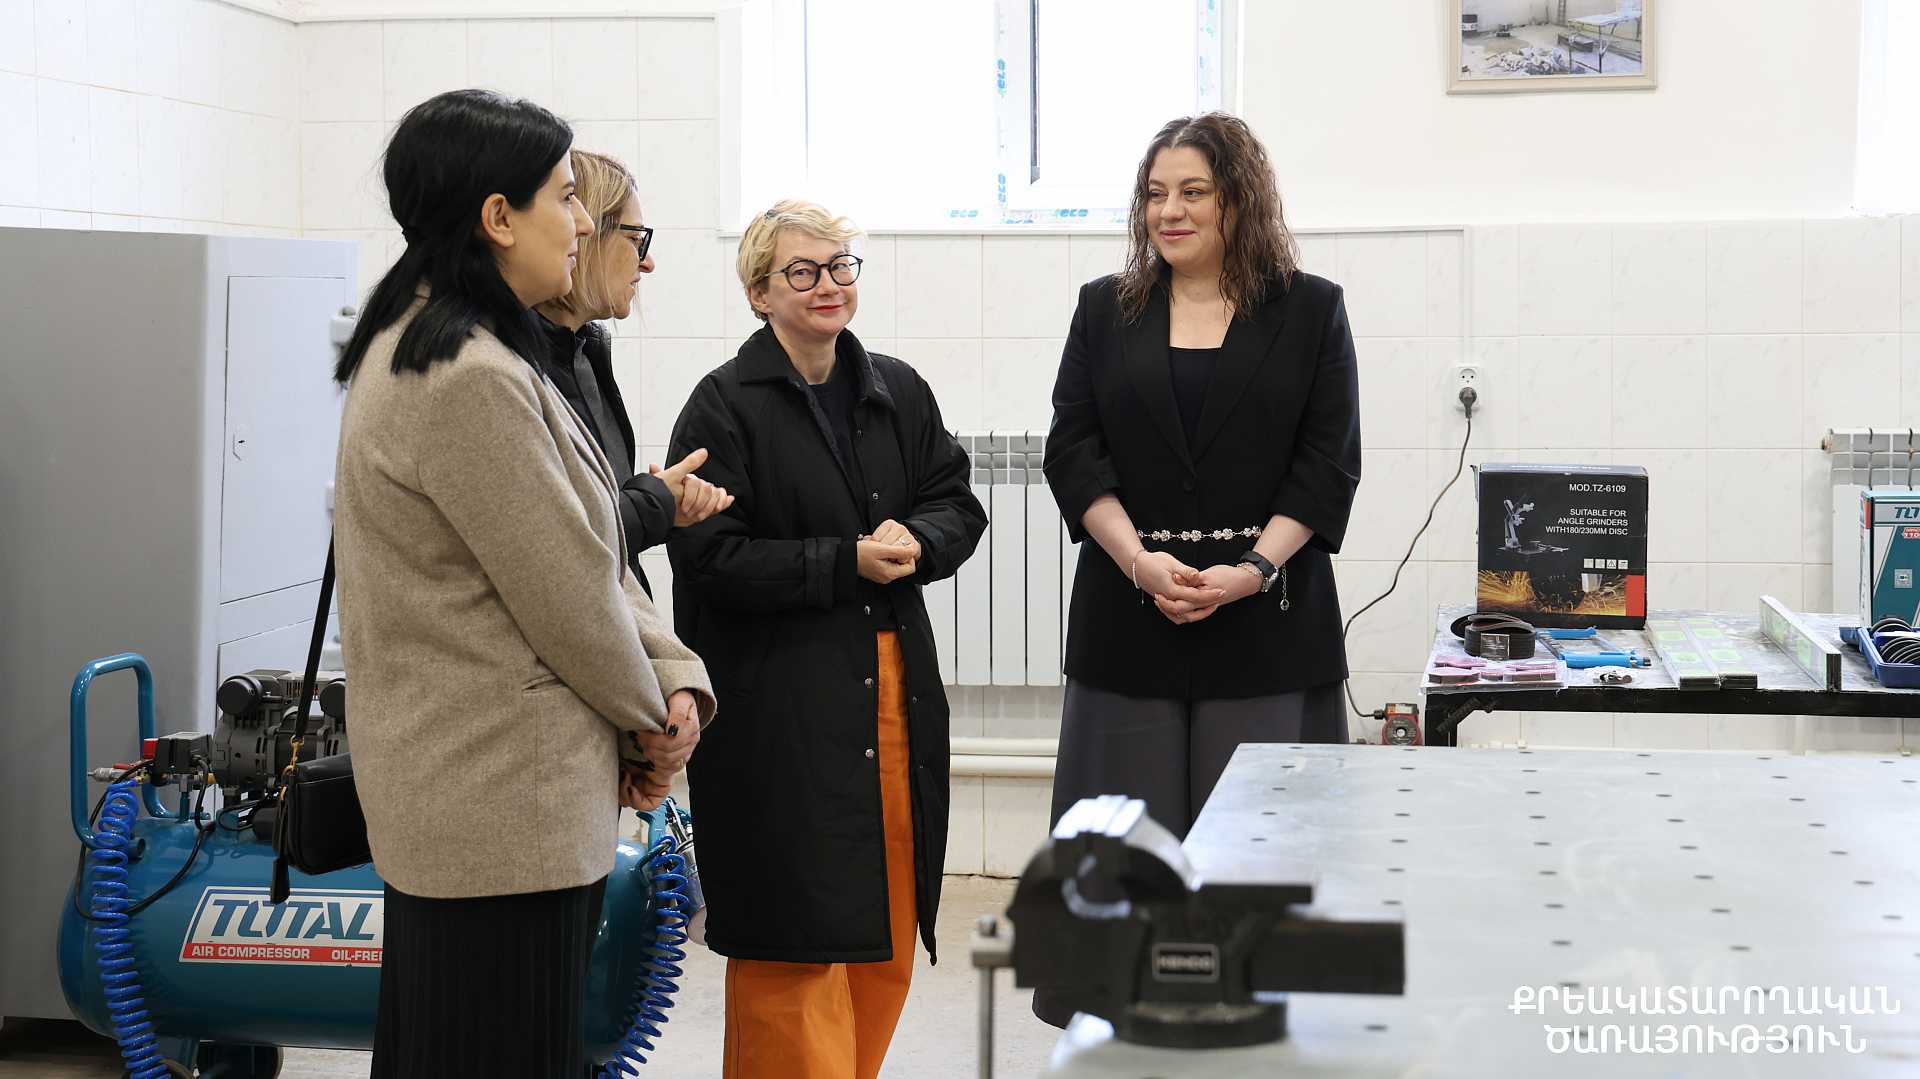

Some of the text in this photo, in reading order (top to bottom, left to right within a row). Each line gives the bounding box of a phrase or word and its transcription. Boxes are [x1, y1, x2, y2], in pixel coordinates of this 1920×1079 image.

[1059, 208, 1088, 218] eco
[1569, 483, 1626, 493] MOD.TZ-6109
[1570, 508, 1627, 517] SUITABLE FOR
[1557, 517, 1628, 526] ANGLE GRINDERS
[1609, 527, 1628, 536] DISC
[211, 900, 376, 941] TOTAL
[191, 946, 214, 957] AIR
[218, 946, 310, 959] COMPRESSOR
